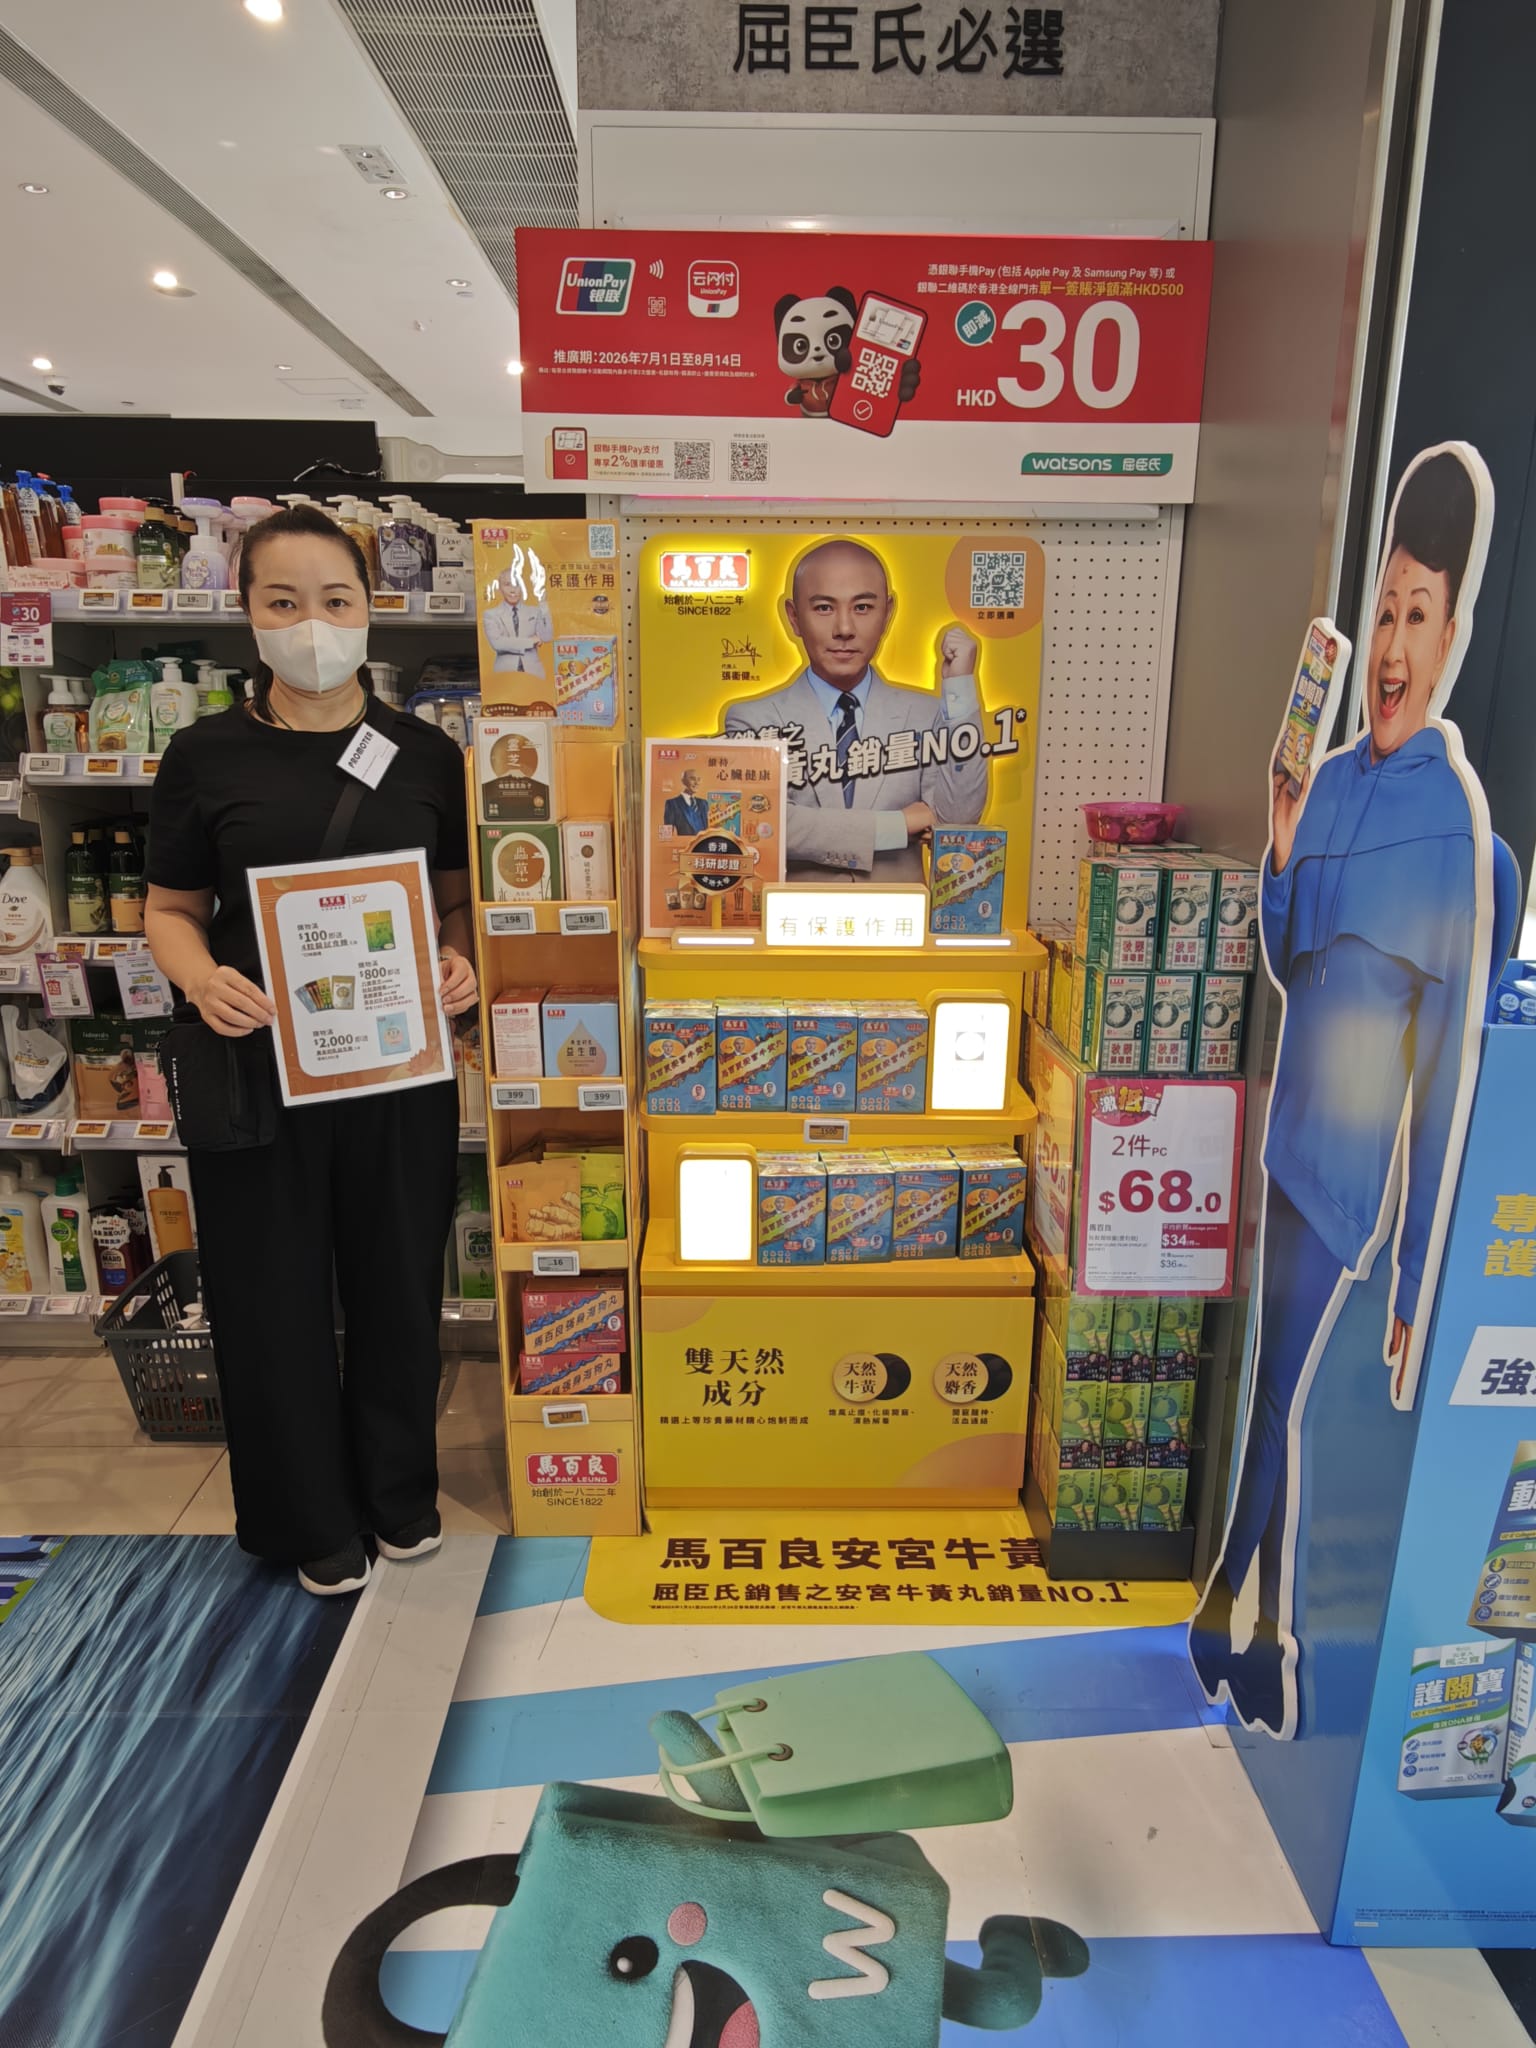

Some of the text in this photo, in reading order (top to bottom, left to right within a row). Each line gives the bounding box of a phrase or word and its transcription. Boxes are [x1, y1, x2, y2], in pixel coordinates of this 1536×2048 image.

[732, 2, 1065, 78] 屈臣氏必選
[692, 271, 735, 288] 云闪付
[1023, 266, 1050, 278] Apple
[1052, 267, 1070, 279] Pay
[1072, 267, 1082, 277] 及
[1084, 267, 1127, 279] Samsung
[1129, 268, 1147, 280] Pay
[1149, 267, 1163, 279] 等)
[1165, 268, 1176, 279] 或
[566, 273, 627, 293] UnionPay
[589, 288, 620, 303] 银联
[956, 299, 1141, 410] HKD 30
[1032, 457, 1162, 473] watsons 屈臣氏
[550, 573, 615, 588] 保護作用
[663, 595, 744, 605] 始創於一八二二年
[21, 606, 40, 622] 30
[677, 606, 731, 616] SINCE1822
[347, 731, 374, 769] PROMOTER
[716, 769, 771, 781] 心臟健康
[708, 842, 728, 852] 香港
[693, 858, 740, 871] 科研認證
[2, 892, 28, 904] Dove
[504, 915, 521, 923] 198
[579, 915, 595, 923] 198
[778, 916, 914, 937] 有保護作用
[298, 930, 328, 943] $100
[359, 967, 387, 980] $800
[314, 1034, 354, 1048] $2,000
[507, 1091, 524, 1099] 399
[593, 1092, 611, 1101] 399
[1111, 1134, 1168, 1158] 2件 PC
[1098, 1169, 1222, 1215] $68.0
[1161, 1233, 1187, 1247] $34
[1160, 1260, 1177, 1269] $36
[684, 1347, 786, 1376] 雙天然
[843, 1361, 877, 1378] 天然
[944, 1362, 978, 1378] 天然
[1481, 1357, 1536, 1396] 強
[702, 1379, 767, 1408] 成分
[843, 1379, 877, 1395] 牛黃
[944, 1378, 978, 1395] 麝香
[536, 1455, 607, 1477] 馬百良
[576, 1476, 608, 1484] LEUNG
[531, 1487, 617, 1497] 始創於一八二二年
[546, 1498, 603, 1506] SINCE1822
